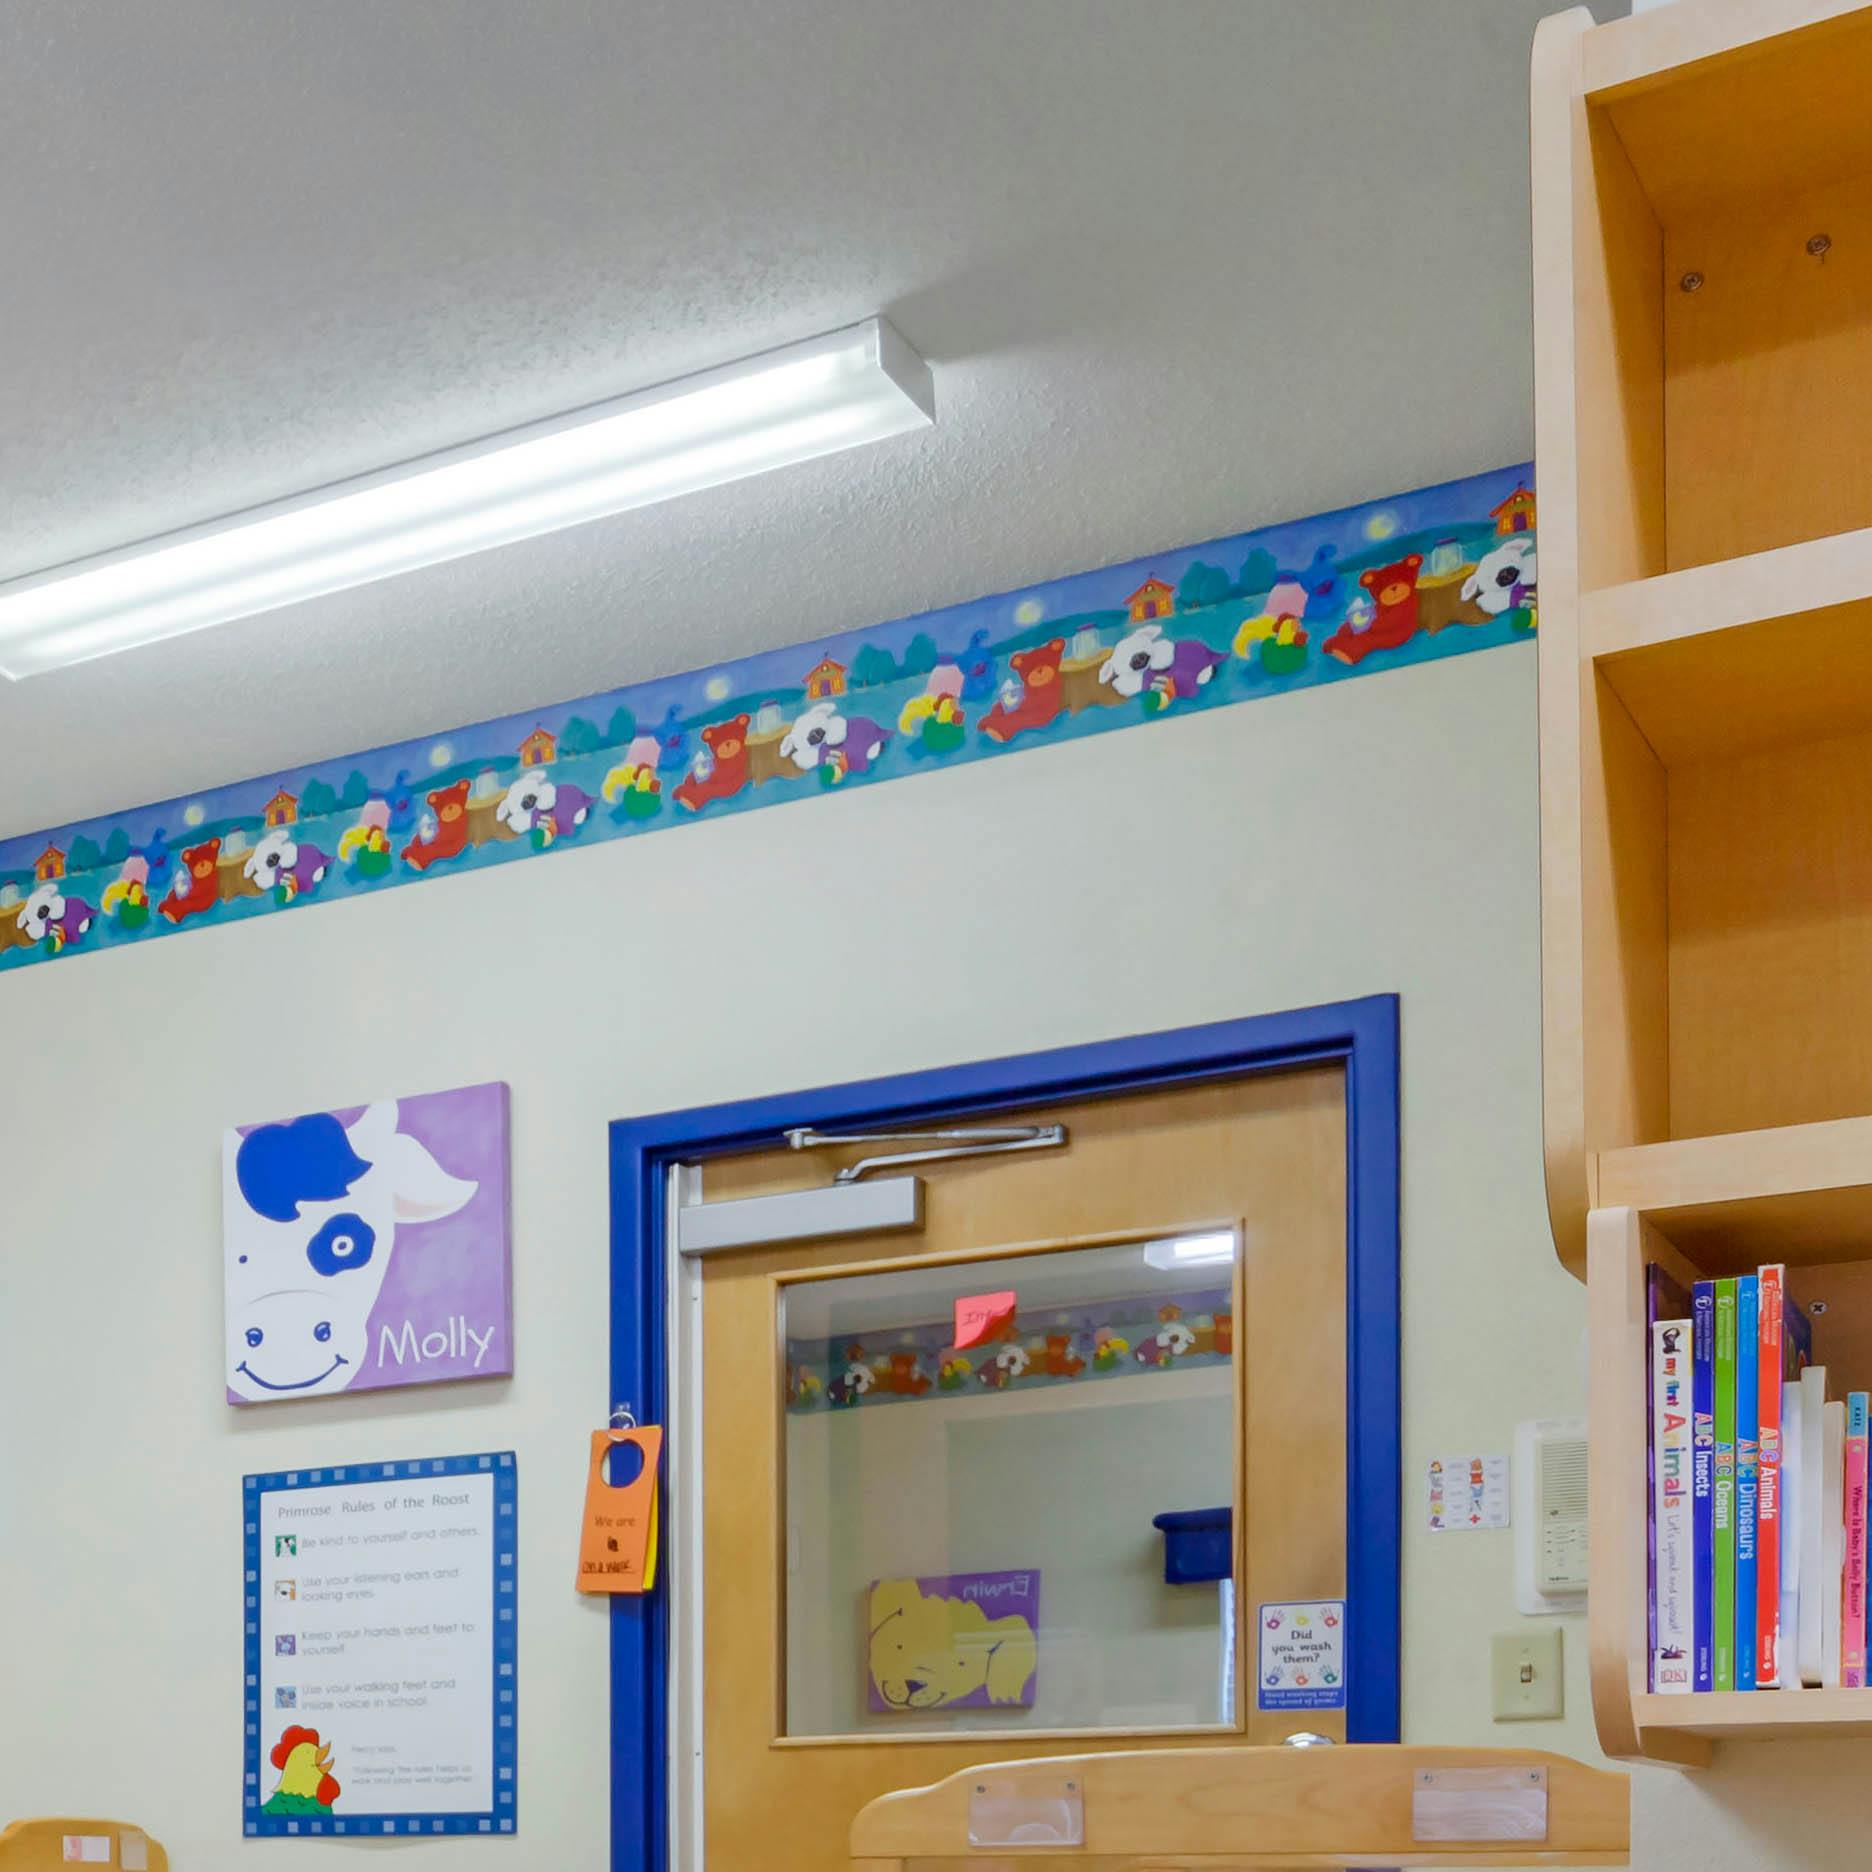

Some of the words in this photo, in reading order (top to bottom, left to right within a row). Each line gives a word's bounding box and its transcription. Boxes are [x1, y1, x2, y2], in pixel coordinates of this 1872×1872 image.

[377, 1315, 496, 1368] Molly
[1663, 1358, 1676, 1376] my
[1694, 1412, 1713, 1448] ABC
[1759, 1426, 1780, 1463] ABC
[1663, 1413, 1687, 1509] Animals
[1695, 1450, 1712, 1498] Insects
[1715, 1441, 1733, 1477] ABC
[1737, 1438, 1759, 1478] ABC
[278, 1505, 332, 1519] Primrose
[342, 1501, 375, 1514] Rules
[384, 1499, 397, 1511] of
[403, 1497, 425, 1510] the
[432, 1493, 470, 1506] Roost
[1715, 1480, 1732, 1529] Oceans
[1759, 1466, 1777, 1520] Animals
[319, 1535, 344, 1547] kind
[347, 1534, 359, 1545] to
[363, 1530, 408, 1545] yourself
[410, 1528, 437, 1541] and
[1739, 1482, 1757, 1560] Dinosaurs
[1272, 1645, 1294, 1656] you
[1299, 1641, 1332, 1652] wash
[1291, 1630, 1313, 1641] Did
[1283, 1652, 1320, 1664] them?
